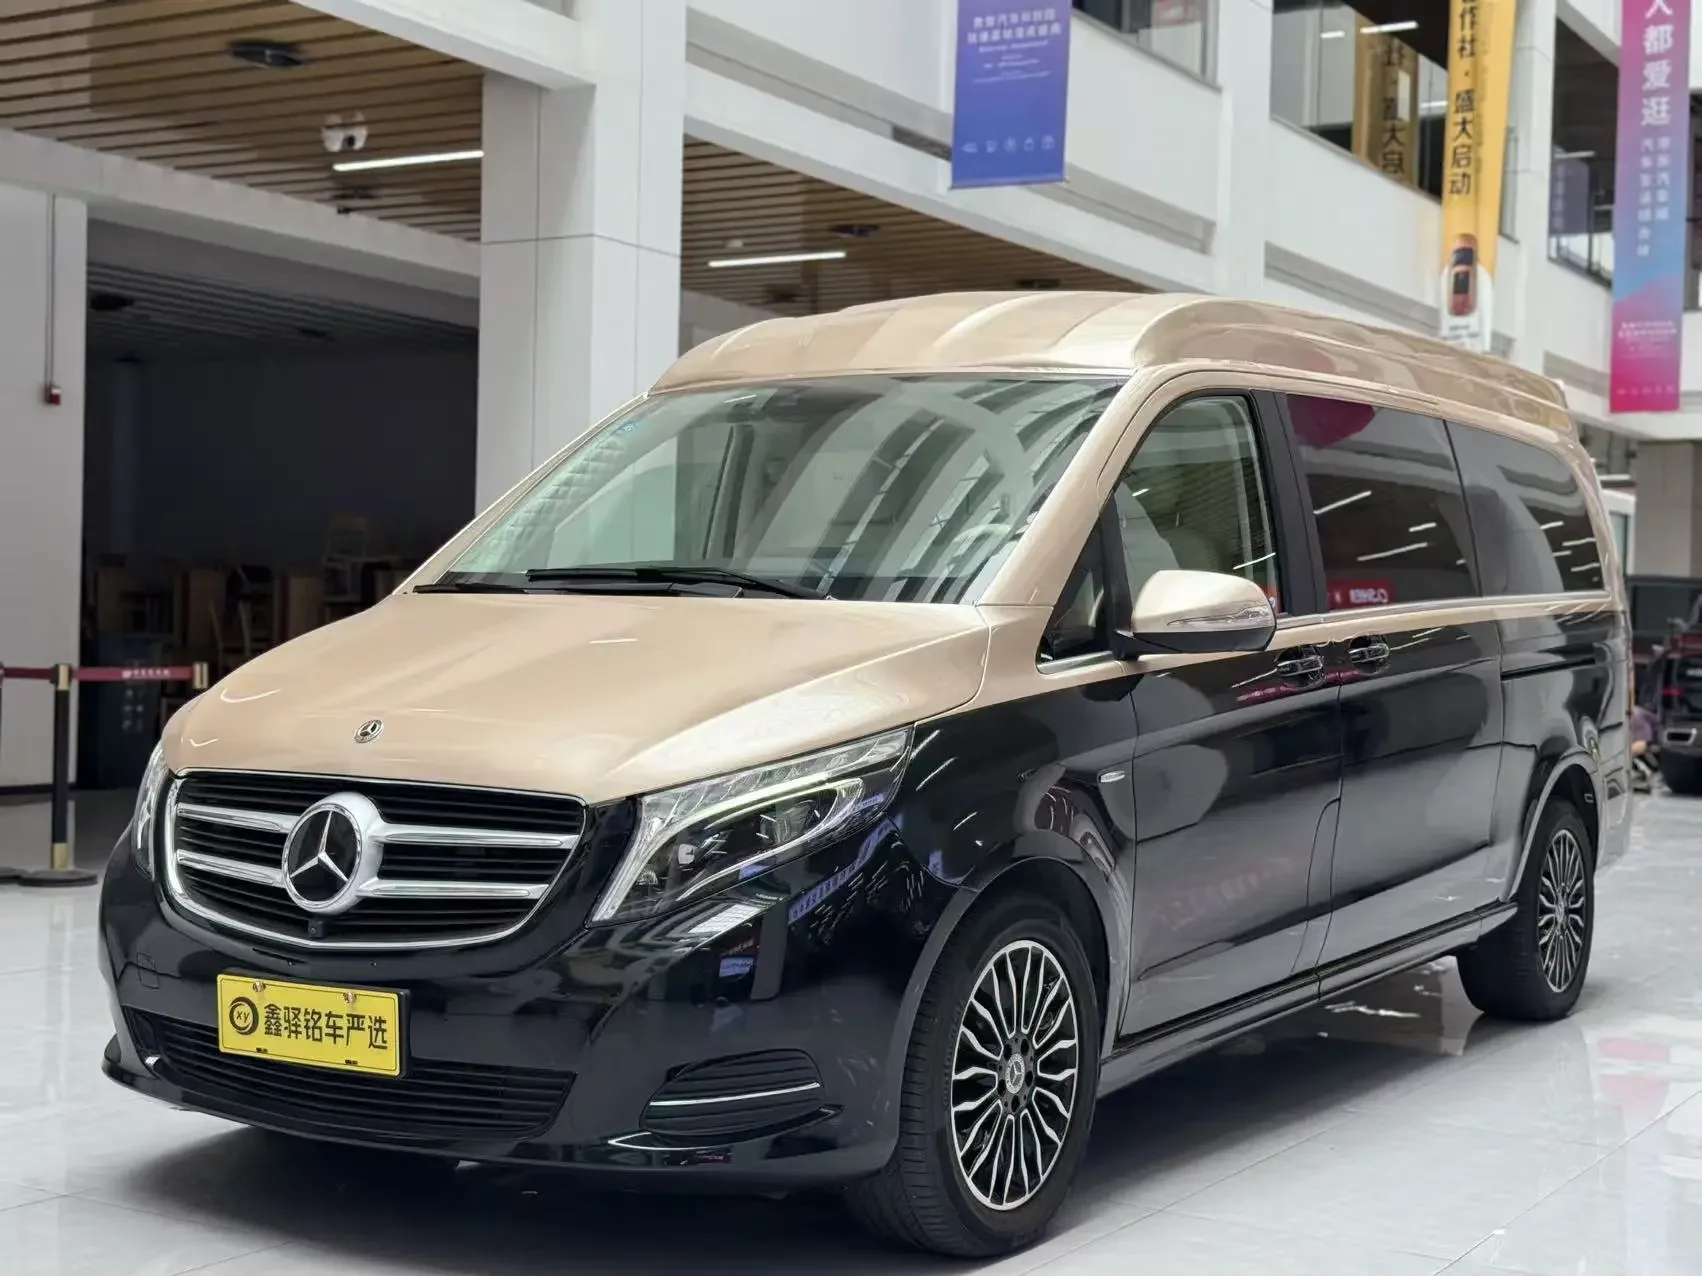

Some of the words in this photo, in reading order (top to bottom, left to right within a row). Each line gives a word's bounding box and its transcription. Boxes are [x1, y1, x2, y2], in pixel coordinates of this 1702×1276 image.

[1449, 0, 1478, 195] 作社·盛大启动
[264, 1003, 388, 1050] 鑫驿铭车严选
